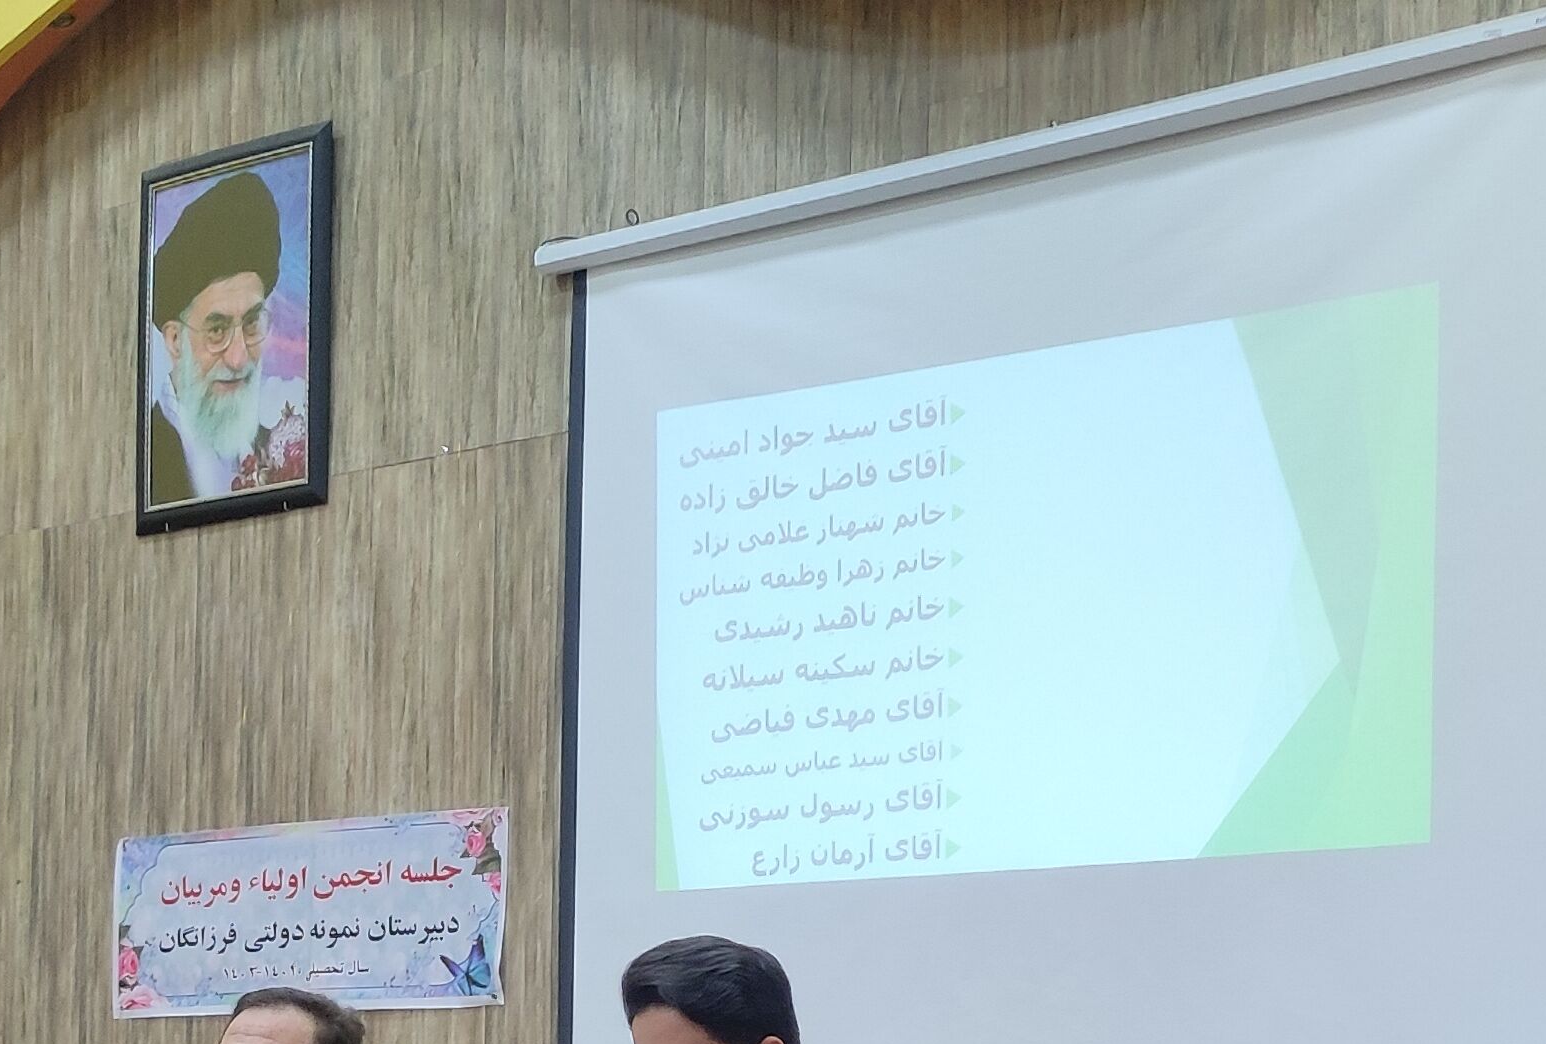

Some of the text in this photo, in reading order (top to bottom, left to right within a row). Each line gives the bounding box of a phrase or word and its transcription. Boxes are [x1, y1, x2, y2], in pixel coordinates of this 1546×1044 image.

[679, 394, 947, 469] آقای سید جواد امینی
[679, 445, 946, 514] آقای فاضل خالق زاده
[892, 501, 946, 536] خانم
[738, 520, 809, 553] علامی
[837, 557, 884, 587] زهرا
[892, 547, 946, 580] خانم
[714, 594, 945, 643] خانم ناهید رشیدی
[794, 653, 876, 685] سکینه
[885, 644, 944, 680] خانم
[710, 687, 945, 743] آقای مهدی فیاضی
[700, 761, 777, 785] سمیعی
[784, 750, 842, 778] عباس
[848, 750, 890, 770] سید
[698, 778, 943, 832] آقای رسول سوزنی
[751, 828, 942, 877] آقای آرمان زارع
[248, 865, 308, 900] اولیاء
[313, 859, 392, 900] انجمن
[400, 856, 463, 889] جلسه
[157, 914, 460, 955] دبیرستان نمونه دولتی فرزانگان
[305, 961, 345, 982] تحصیلی
[347, 959, 370, 976] سال
